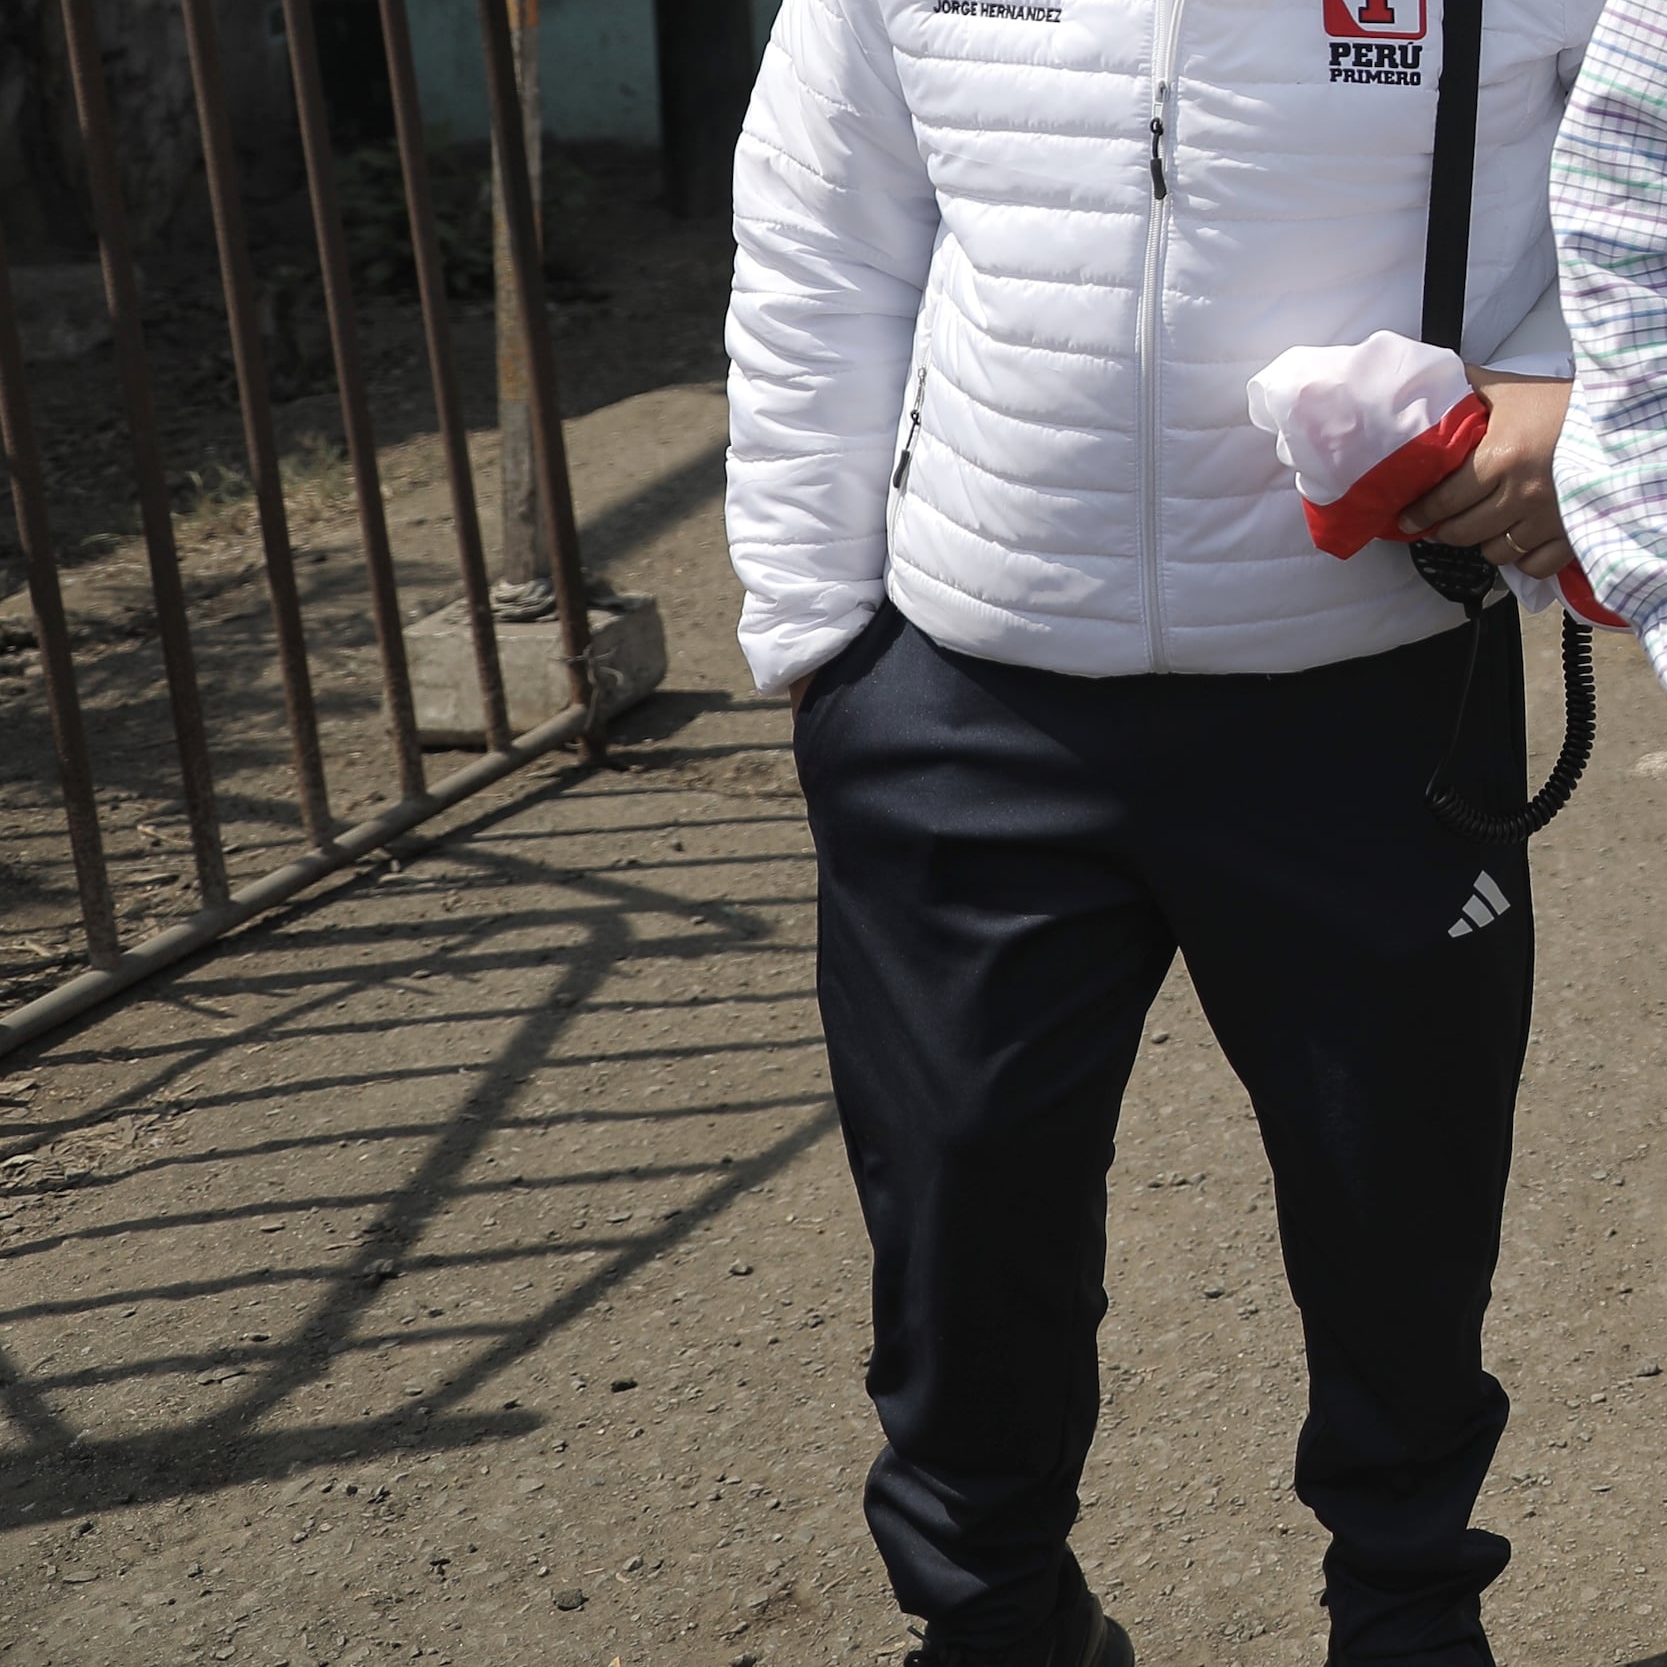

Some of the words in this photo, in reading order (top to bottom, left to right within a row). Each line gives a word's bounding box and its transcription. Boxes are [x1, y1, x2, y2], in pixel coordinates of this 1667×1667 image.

[933, 0, 978, 16] JORGE
[980, 2, 1062, 23] HERNANDEZ
[1328, 41, 1423, 69] PERÚ
[1329, 68, 1421, 86] PRIMERO
